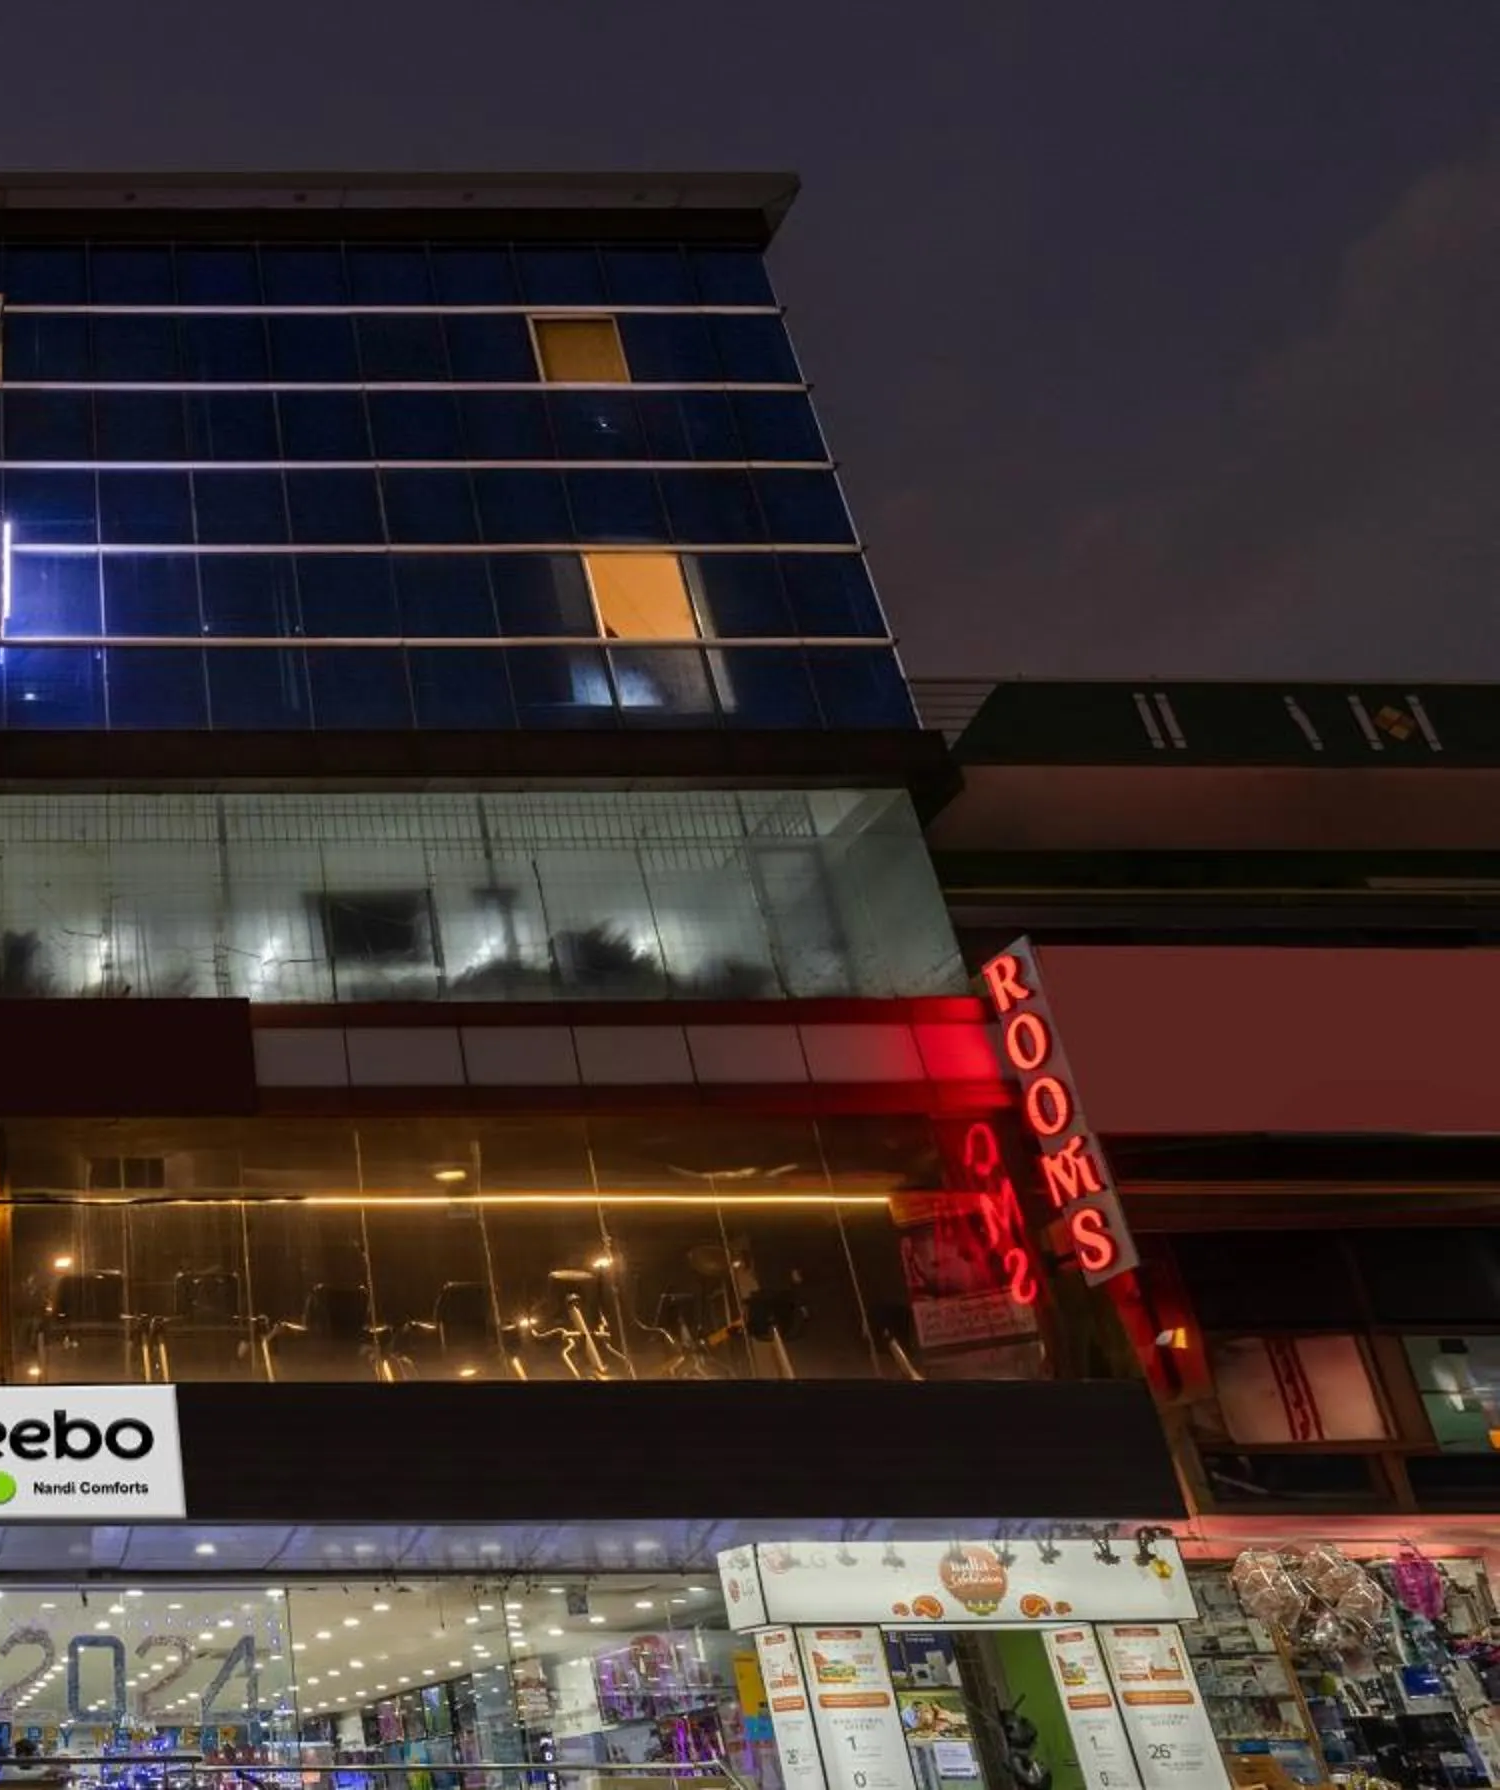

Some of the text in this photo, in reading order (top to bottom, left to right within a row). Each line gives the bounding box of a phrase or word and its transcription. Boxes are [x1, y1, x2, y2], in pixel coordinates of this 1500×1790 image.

[983, 954, 1116, 1272] ROOMS
[33, 1481, 149, 1495] Nandi Comforts
[0, 1627, 271, 1722] 2024
